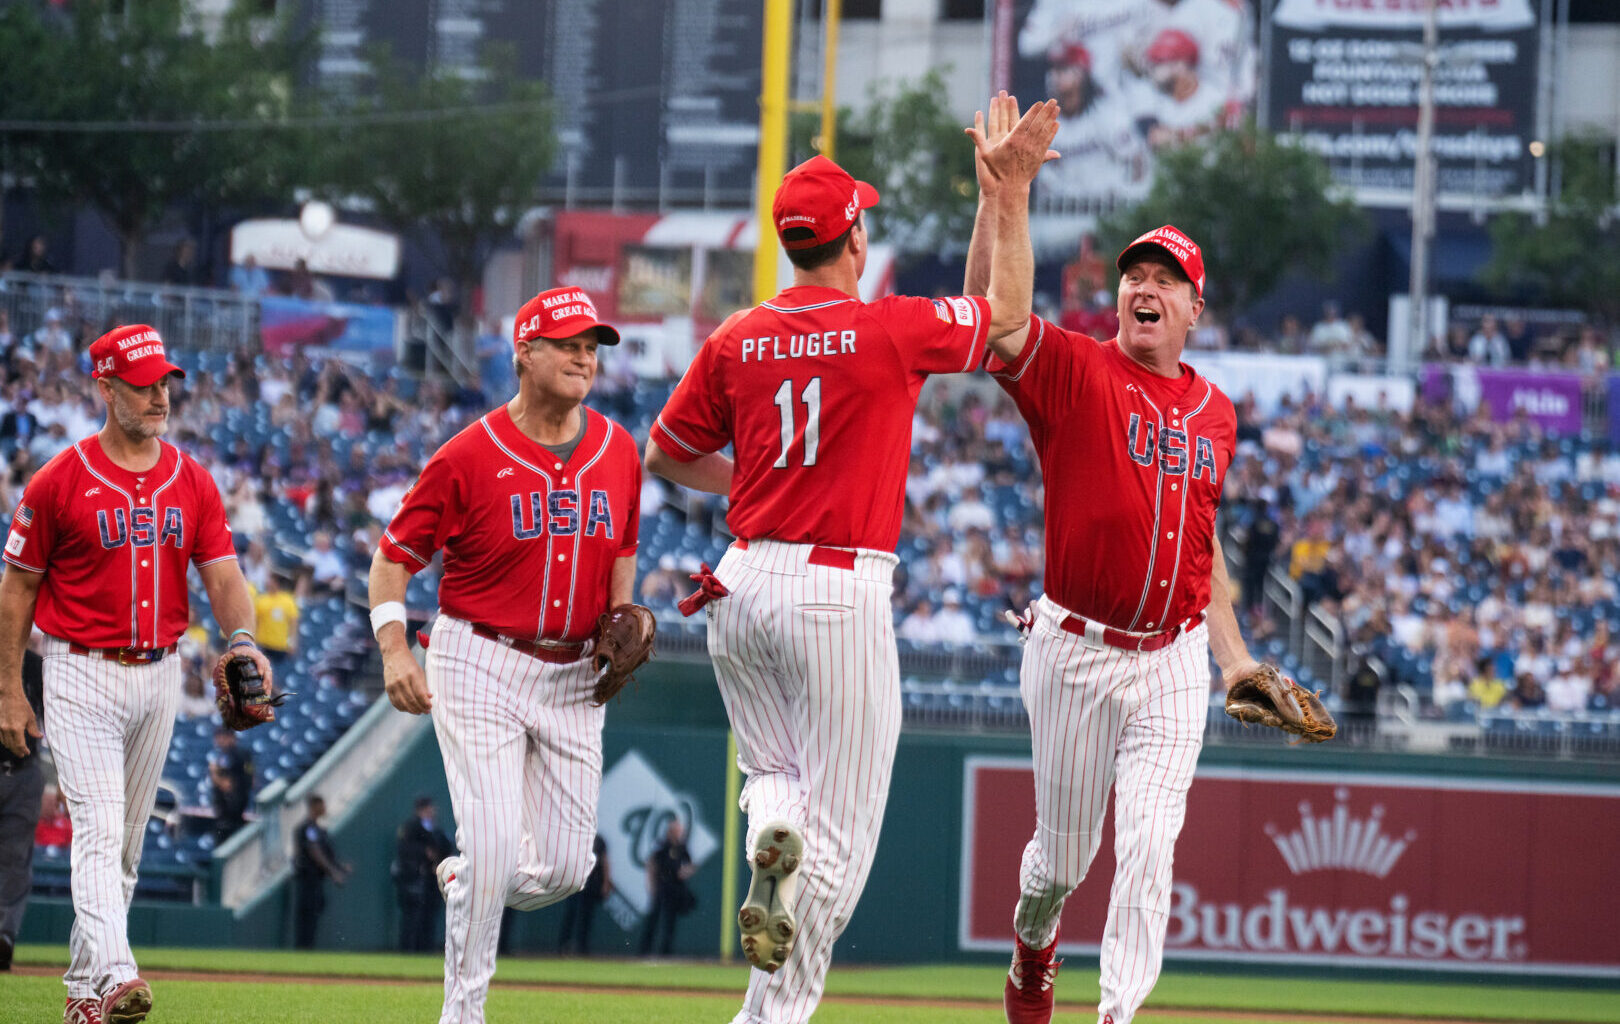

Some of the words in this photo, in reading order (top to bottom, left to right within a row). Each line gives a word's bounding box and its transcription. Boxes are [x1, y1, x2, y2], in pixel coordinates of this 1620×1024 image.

[1156, 228, 1197, 256] AMERICA
[1162, 240, 1190, 263] AGAIN
[542, 293, 571, 310] MAKE
[551, 305, 582, 321] GREAT
[117, 333, 144, 352] MAKE
[126, 344, 153, 362] GREAT
[741, 329, 857, 363] PFLUGER
[772, 375, 822, 470] 11
[1126, 411, 1218, 486] USA
[96, 507, 184, 550] USA
[509, 489, 615, 541] USA
[1164, 881, 1526, 960] Budweiser
